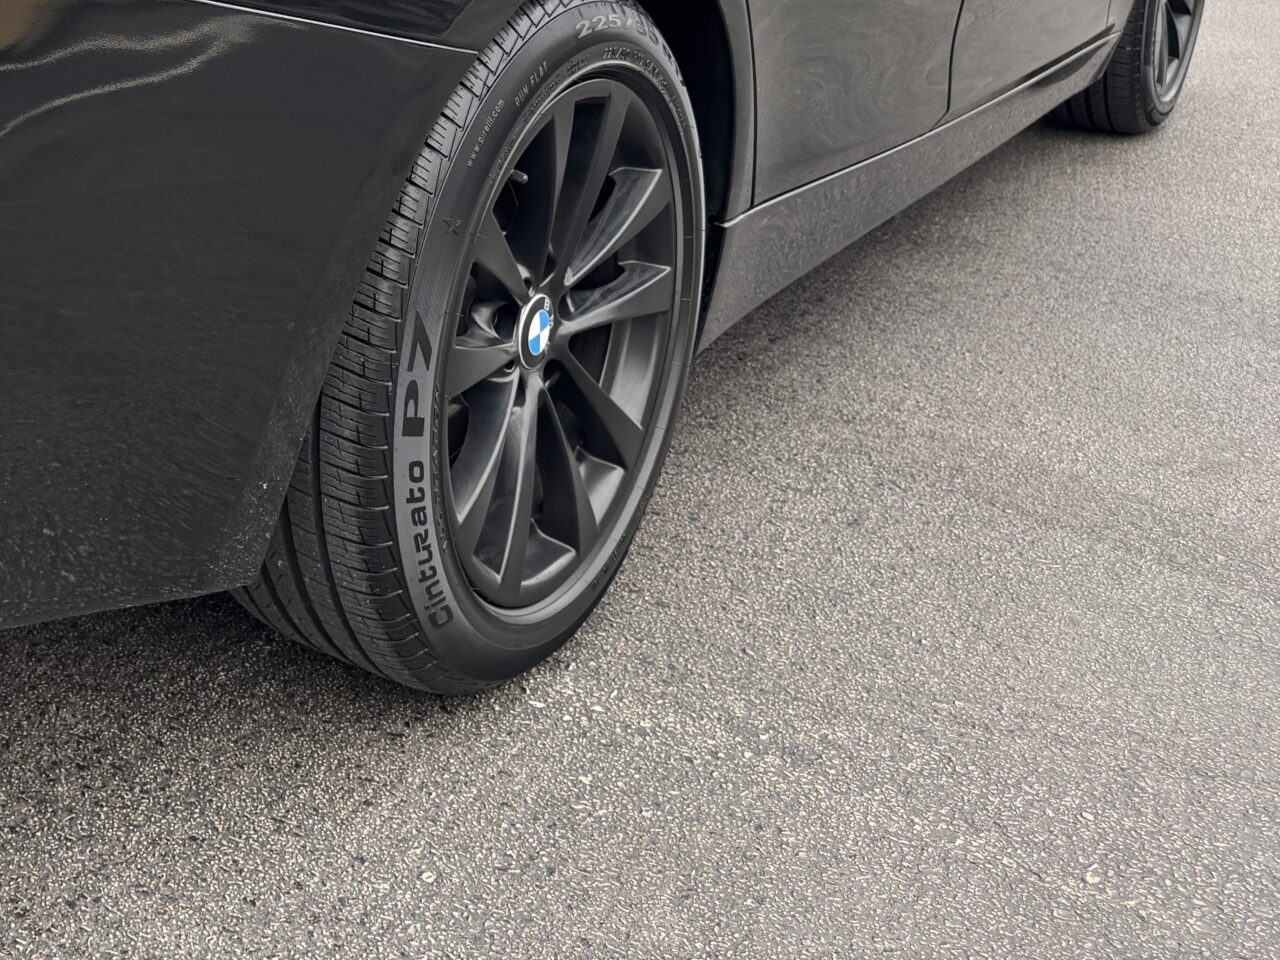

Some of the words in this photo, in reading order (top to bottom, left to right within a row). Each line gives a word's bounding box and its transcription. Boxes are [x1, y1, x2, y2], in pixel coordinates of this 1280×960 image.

[466, 99, 505, 168] www.pirelli.com
[514, 85, 531, 108] RUN
[530, 60, 549, 87] FLAT
[401, 310, 433, 438] P7
[405, 459, 455, 630] Cinturato
